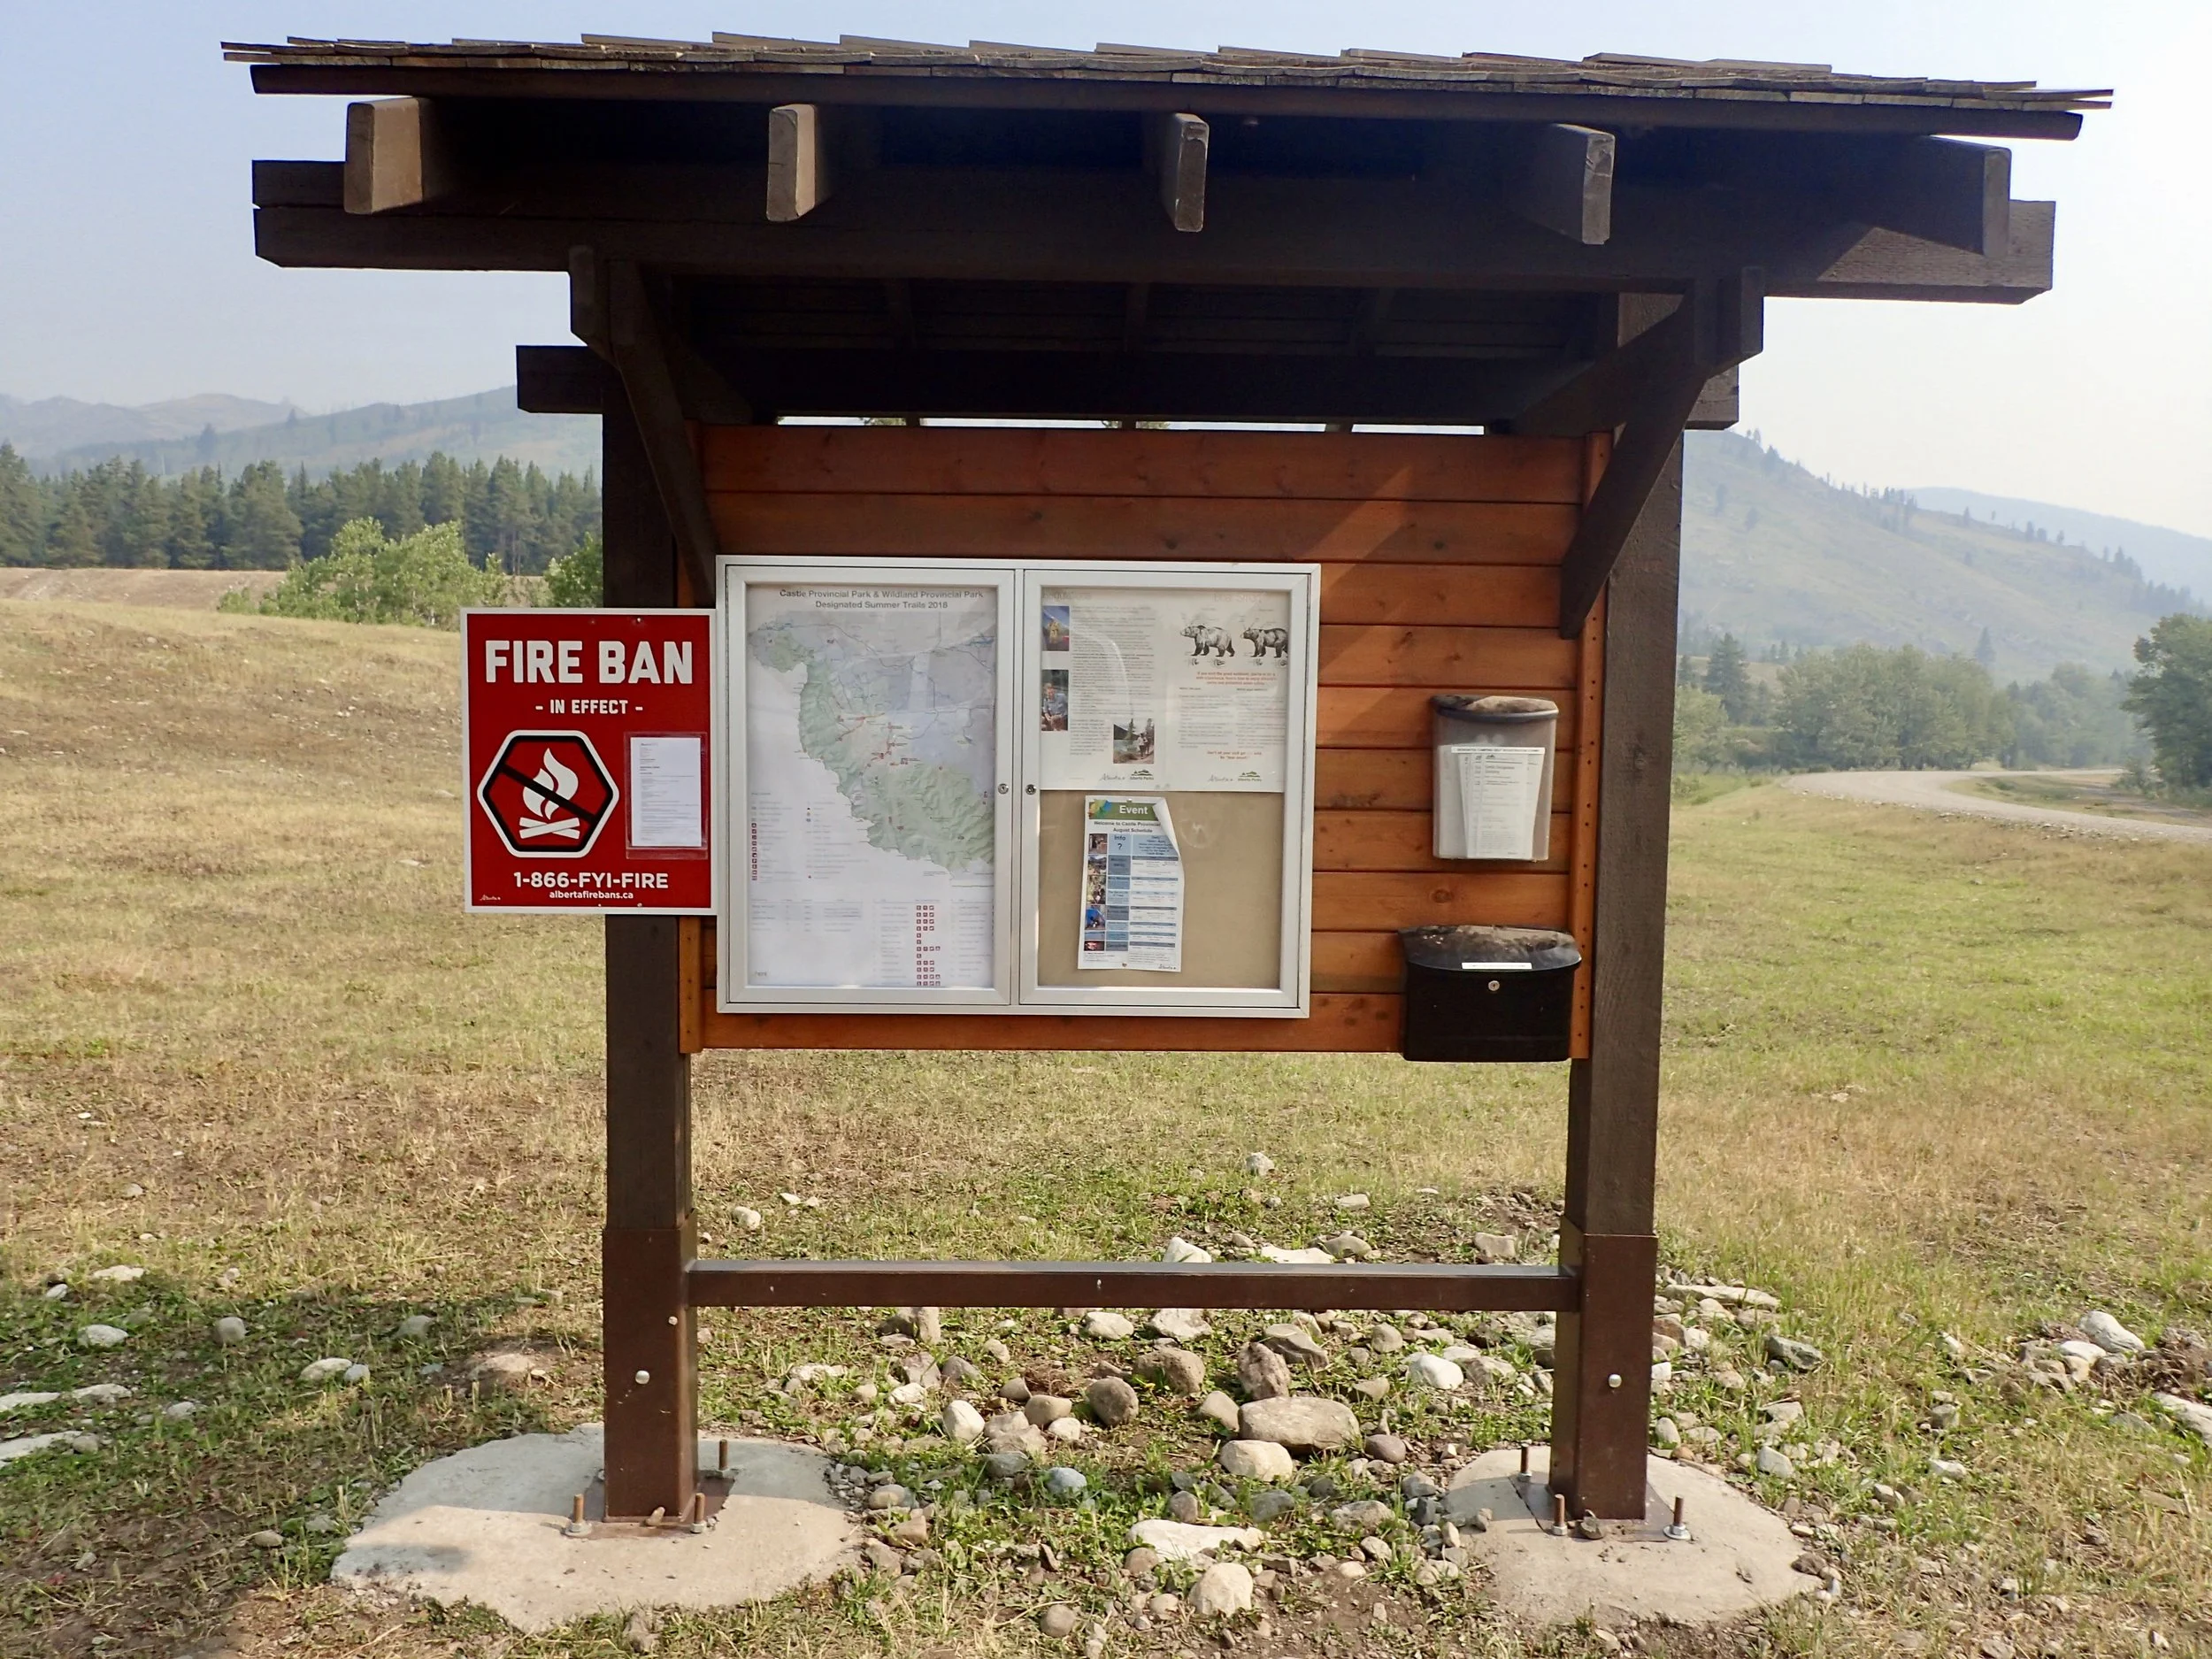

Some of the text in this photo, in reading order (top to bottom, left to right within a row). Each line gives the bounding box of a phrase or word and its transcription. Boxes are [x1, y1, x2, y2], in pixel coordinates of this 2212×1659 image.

[816, 601, 863, 610] Designated
[486, 641, 692, 684] FIRE BAN
[550, 700, 565, 713] IN
[572, 700, 628, 714] EFFECT
[1119, 805, 1148, 815] Event
[514, 872, 668, 888] 1-866-FYI-FIRE
